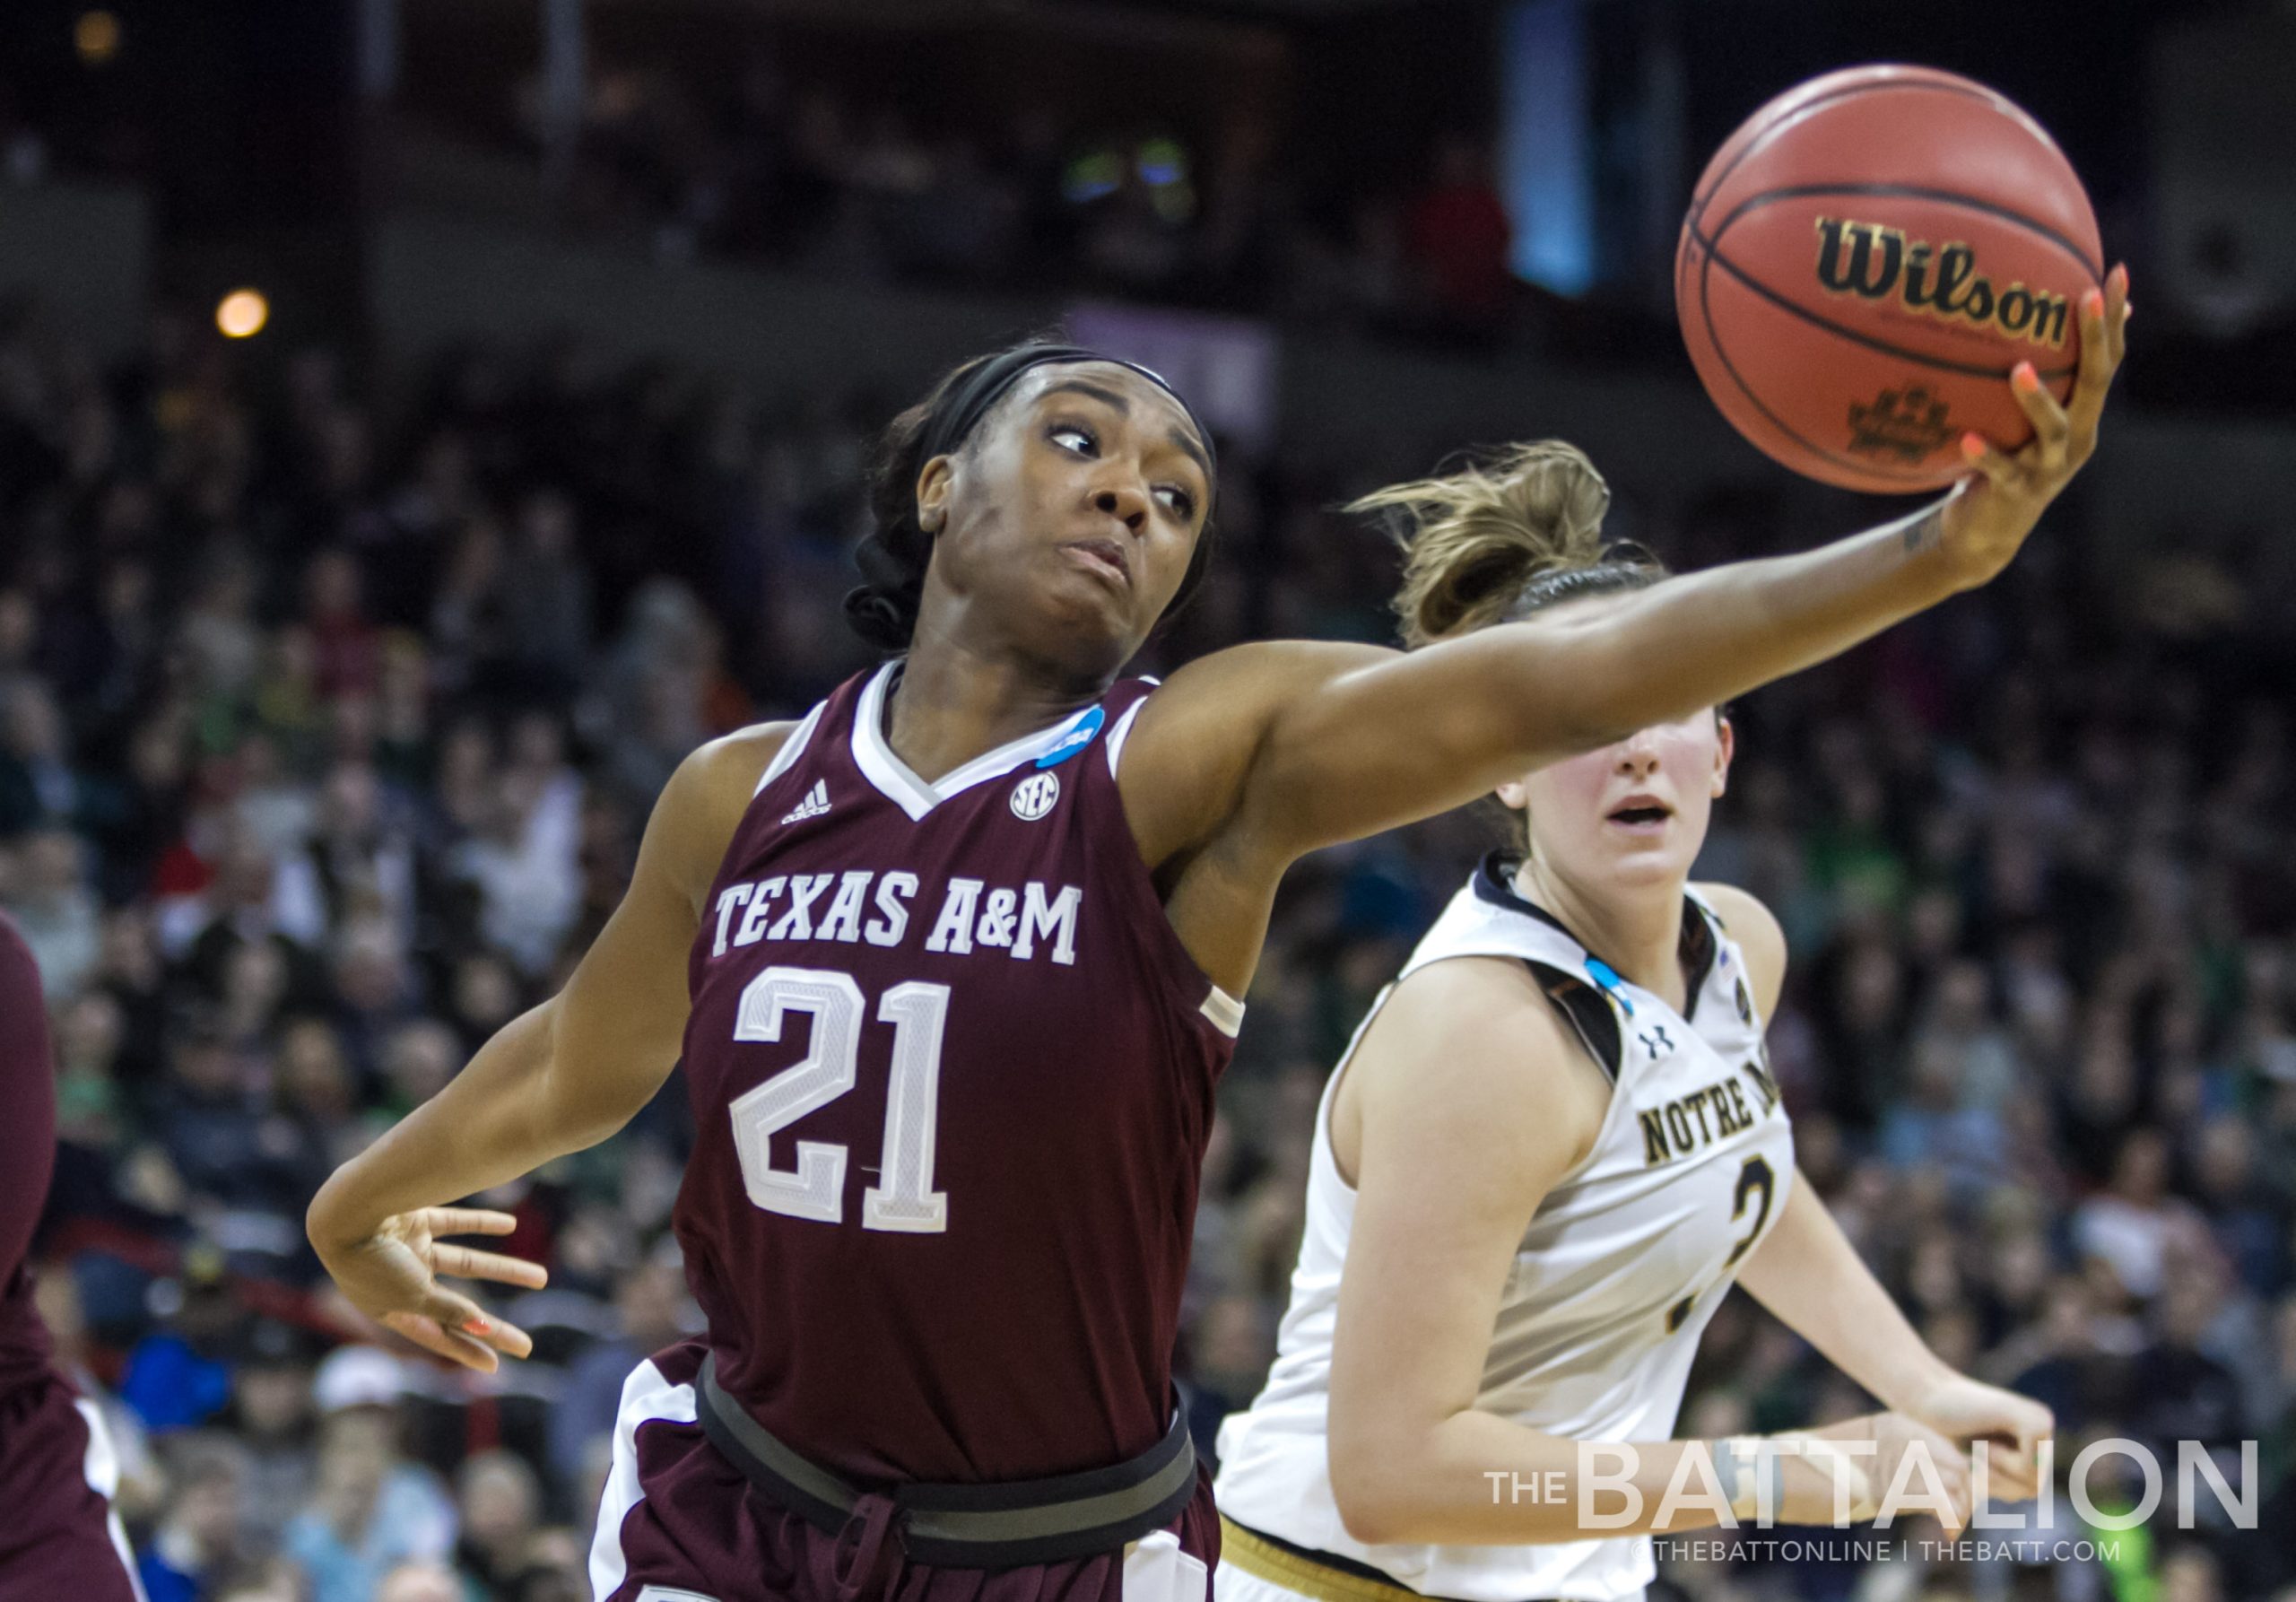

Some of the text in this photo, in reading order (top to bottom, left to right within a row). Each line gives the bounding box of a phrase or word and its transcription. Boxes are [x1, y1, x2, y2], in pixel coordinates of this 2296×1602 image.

[1815, 216, 2070, 348] Wilson
[1013, 772, 1057, 818] SEC
[713, 871, 1082, 965] TEXAS A&M
[728, 966, 951, 1233] 21
[1638, 1077, 1753, 1167] NOTRE
